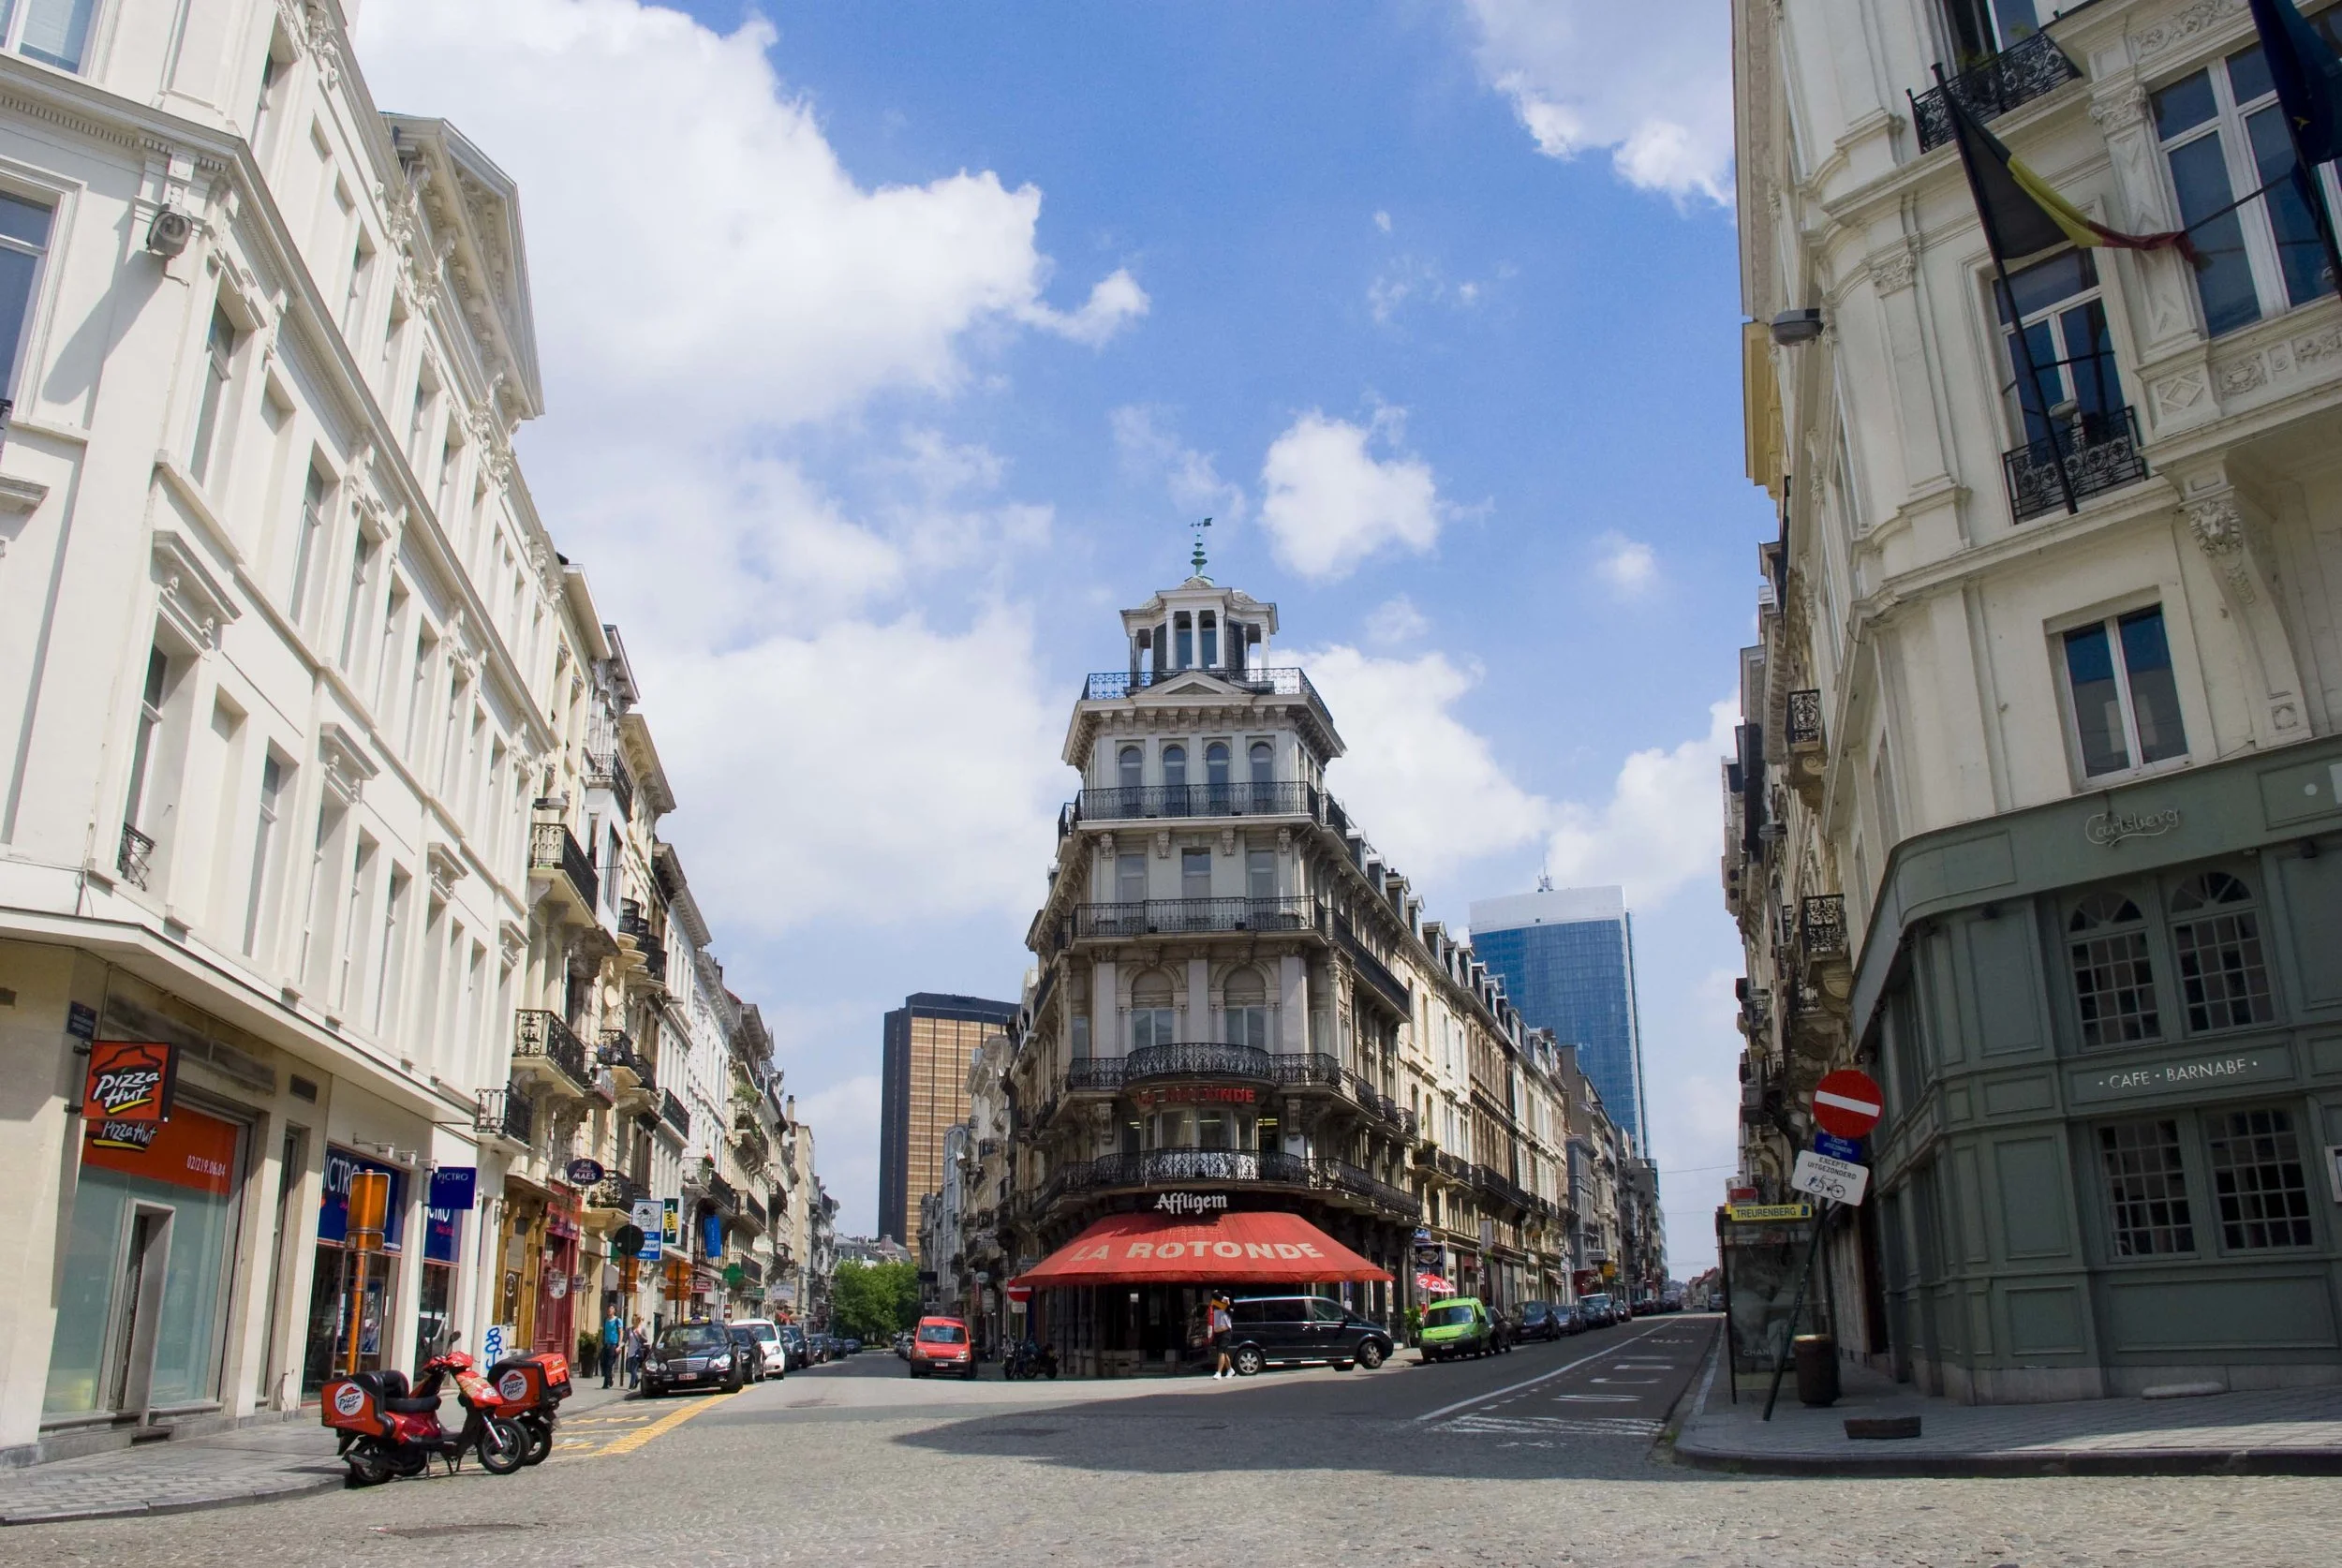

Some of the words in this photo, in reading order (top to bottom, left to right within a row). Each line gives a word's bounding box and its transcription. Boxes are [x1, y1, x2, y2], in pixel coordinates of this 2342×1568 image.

[2085, 808, 2180, 847] Carlsberg
[2109, 1071, 2151, 1089] CAFE
[2166, 1058, 2246, 1082] BARNABE
[93, 1071, 160, 1100] Pizza
[104, 1086, 152, 1108] Hut
[102, 1121, 133, 1141] Pizza
[133, 1122, 157, 1145] Hut
[1807, 1161, 1858, 1180] UITGEZONDERD
[1818, 1156, 1850, 1171] EXCEPTE
[571, 1172, 596, 1180] MAES
[1153, 1192, 1228, 1215] Affligem
[1736, 1206, 1797, 1219] TREURENBERG
[1069, 1244, 1111, 1262] LA
[1125, 1240, 1326, 1260] ROTONDE
